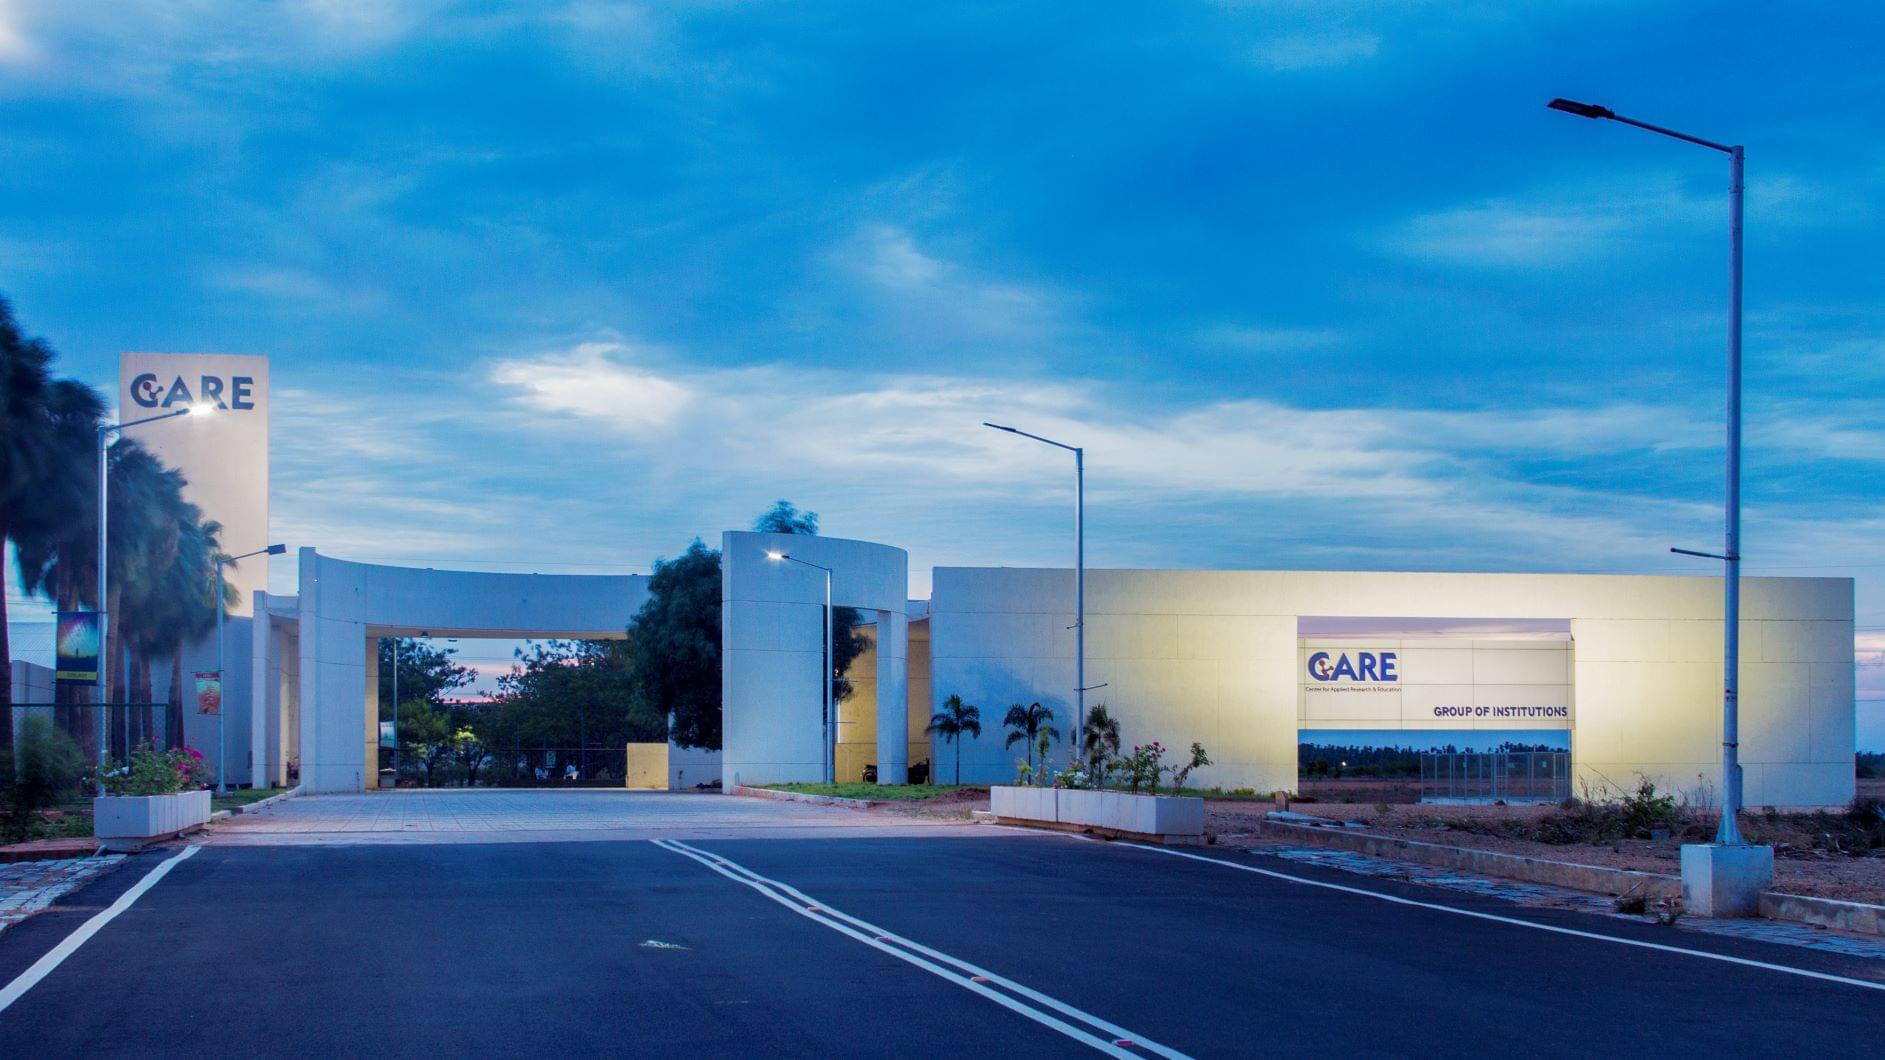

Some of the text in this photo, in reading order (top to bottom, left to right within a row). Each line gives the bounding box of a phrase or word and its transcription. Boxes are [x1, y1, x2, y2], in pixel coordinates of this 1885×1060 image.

[130, 373, 254, 410] CARE
[1308, 652, 1398, 681] CARE
[1433, 706, 1567, 717] GROUP OF INSTITUTIONS
